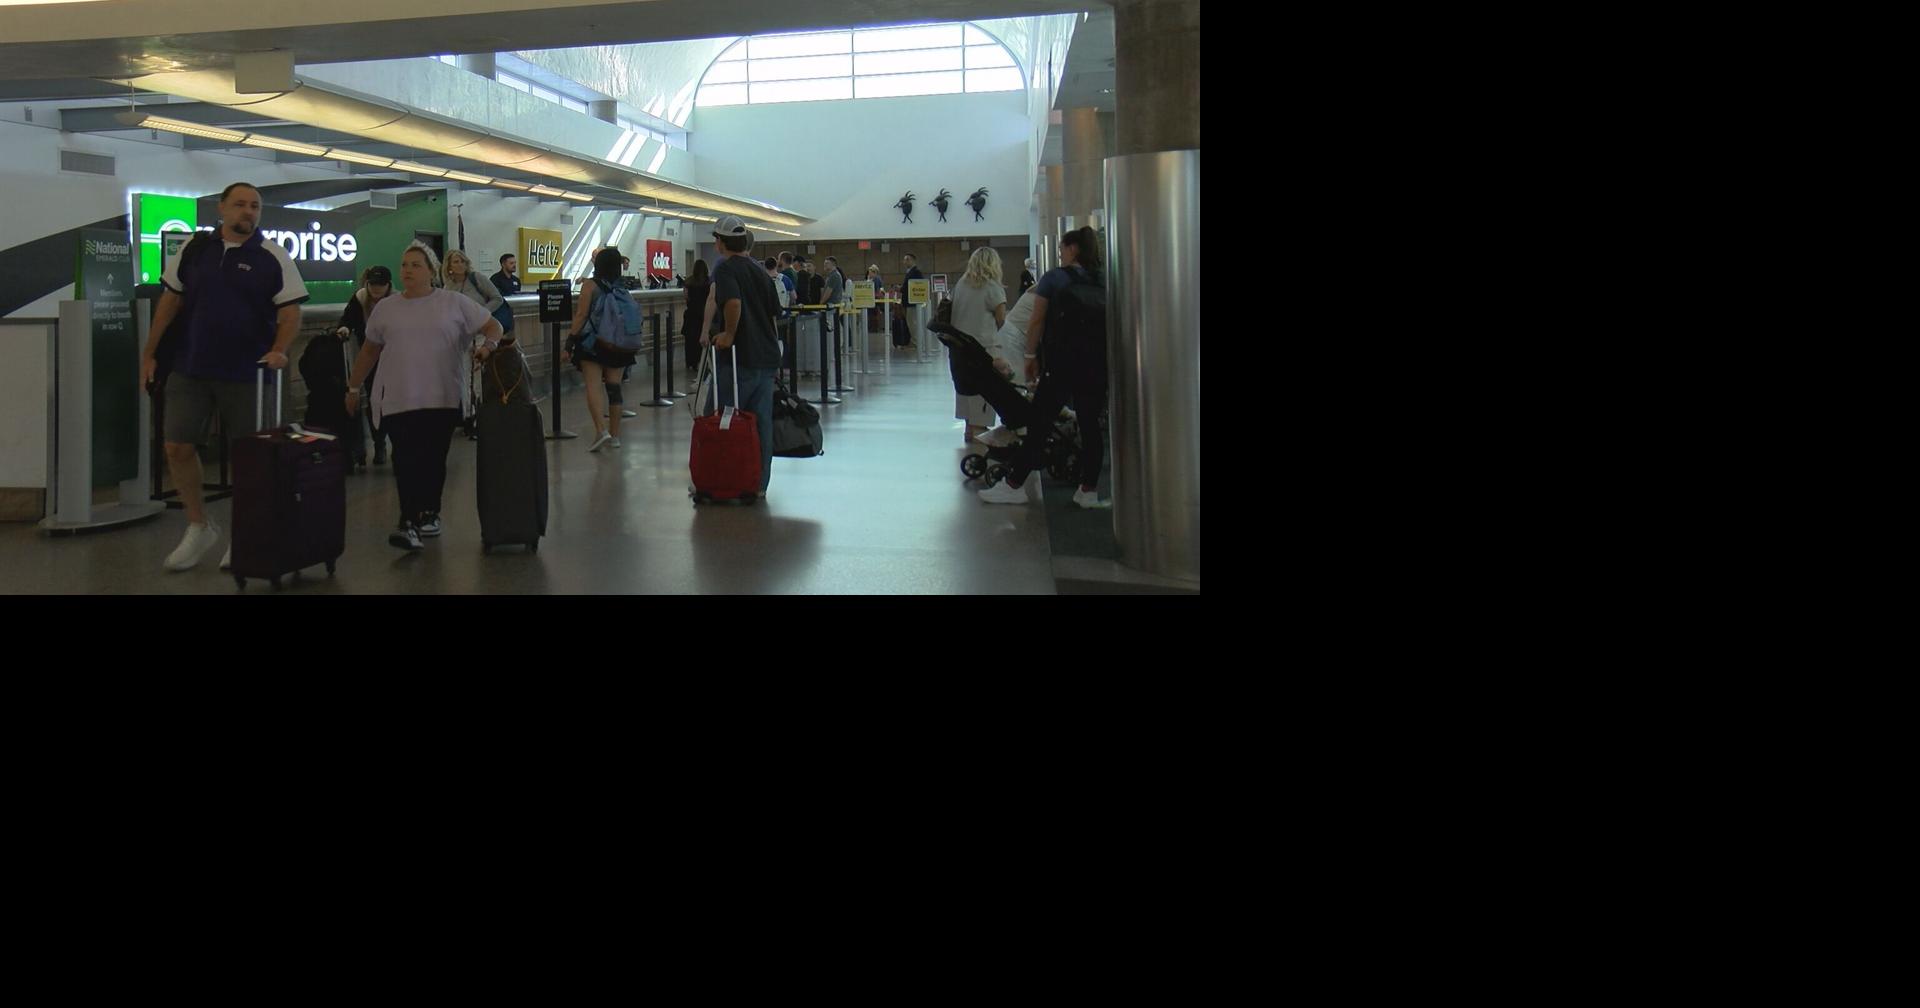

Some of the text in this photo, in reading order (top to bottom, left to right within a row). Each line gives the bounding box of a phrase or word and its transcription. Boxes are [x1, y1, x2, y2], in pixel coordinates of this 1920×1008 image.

[95, 240, 130, 254] National
[158, 219, 358, 262] rprise
[528, 239, 560, 266] Hertz
[653, 251, 670, 269] dollar
